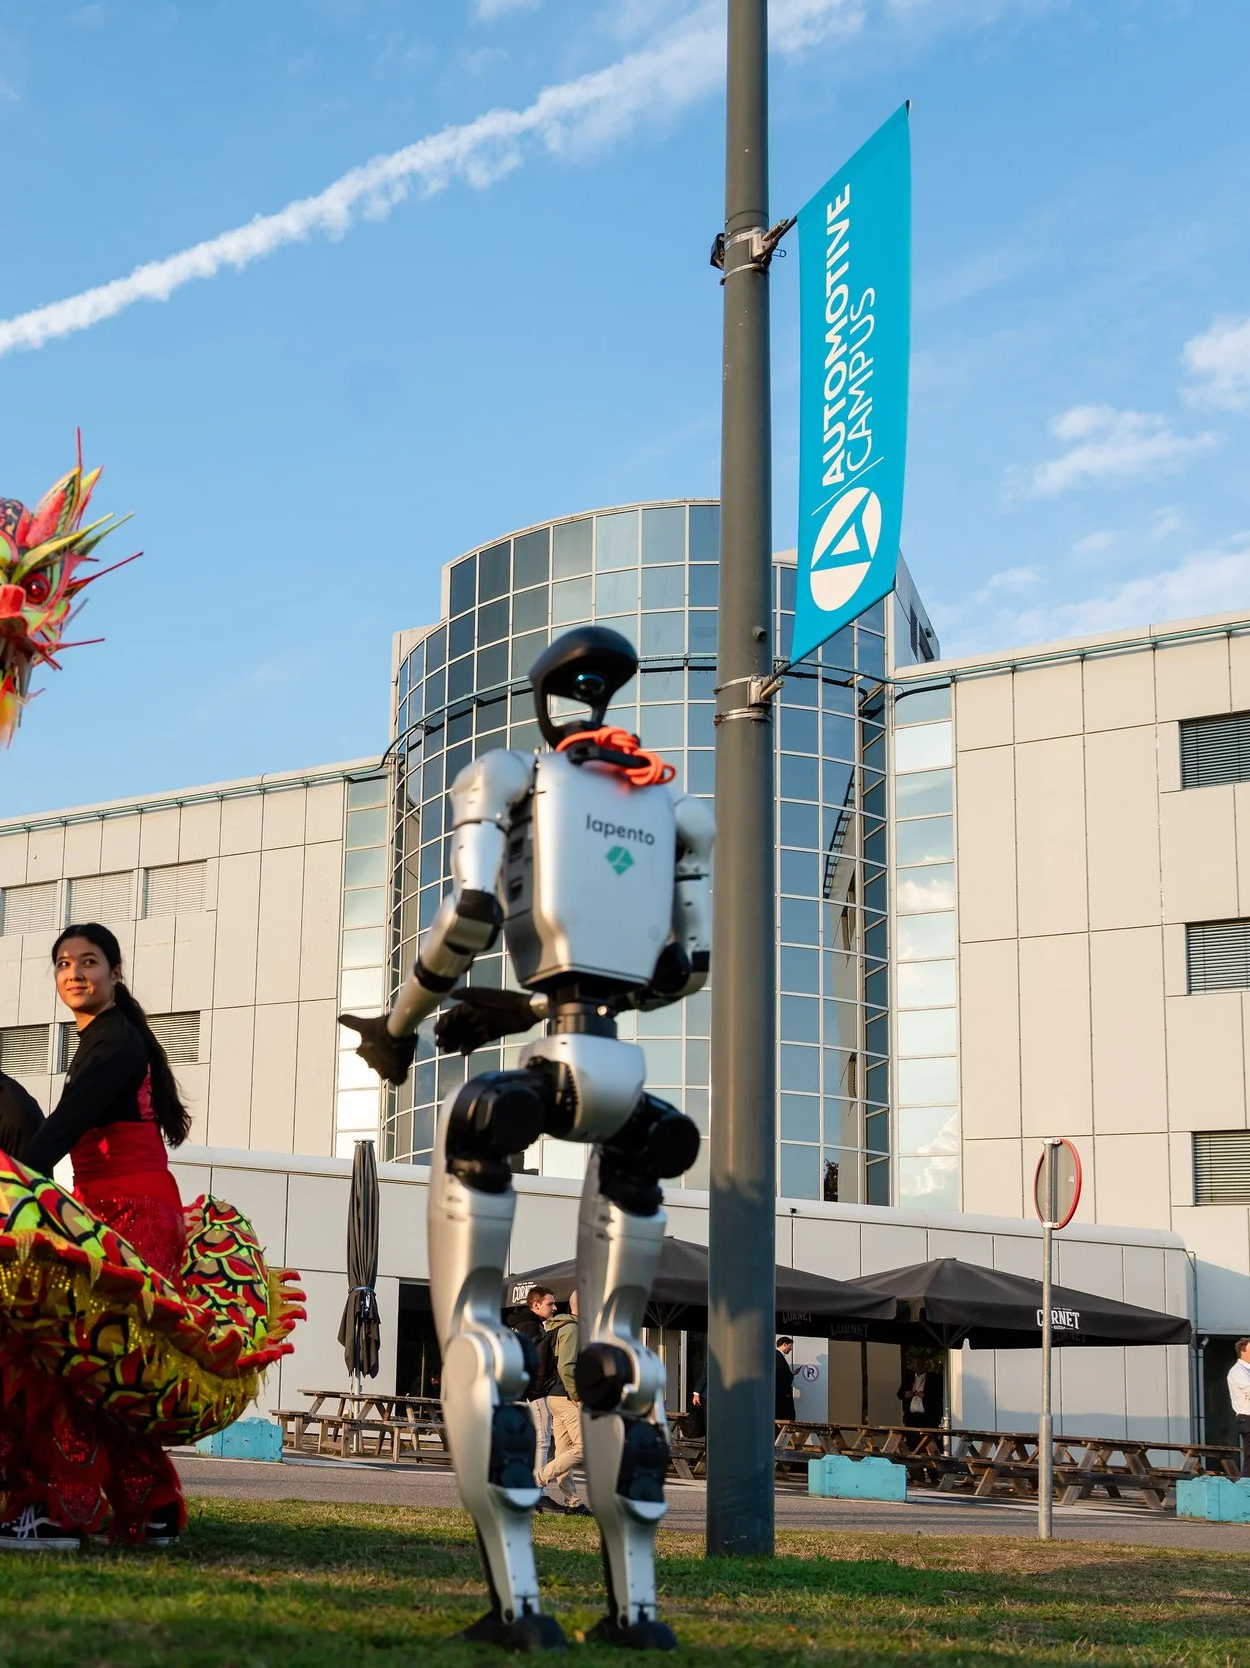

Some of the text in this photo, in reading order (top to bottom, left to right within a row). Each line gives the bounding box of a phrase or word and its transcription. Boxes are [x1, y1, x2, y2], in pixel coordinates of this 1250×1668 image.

[822, 183, 850, 486] AUTOMOTIVE
[847, 287, 875, 471] CAMPUS
[586, 813, 655, 846] lapento
[1036, 1309, 1080, 1330] CRNET
